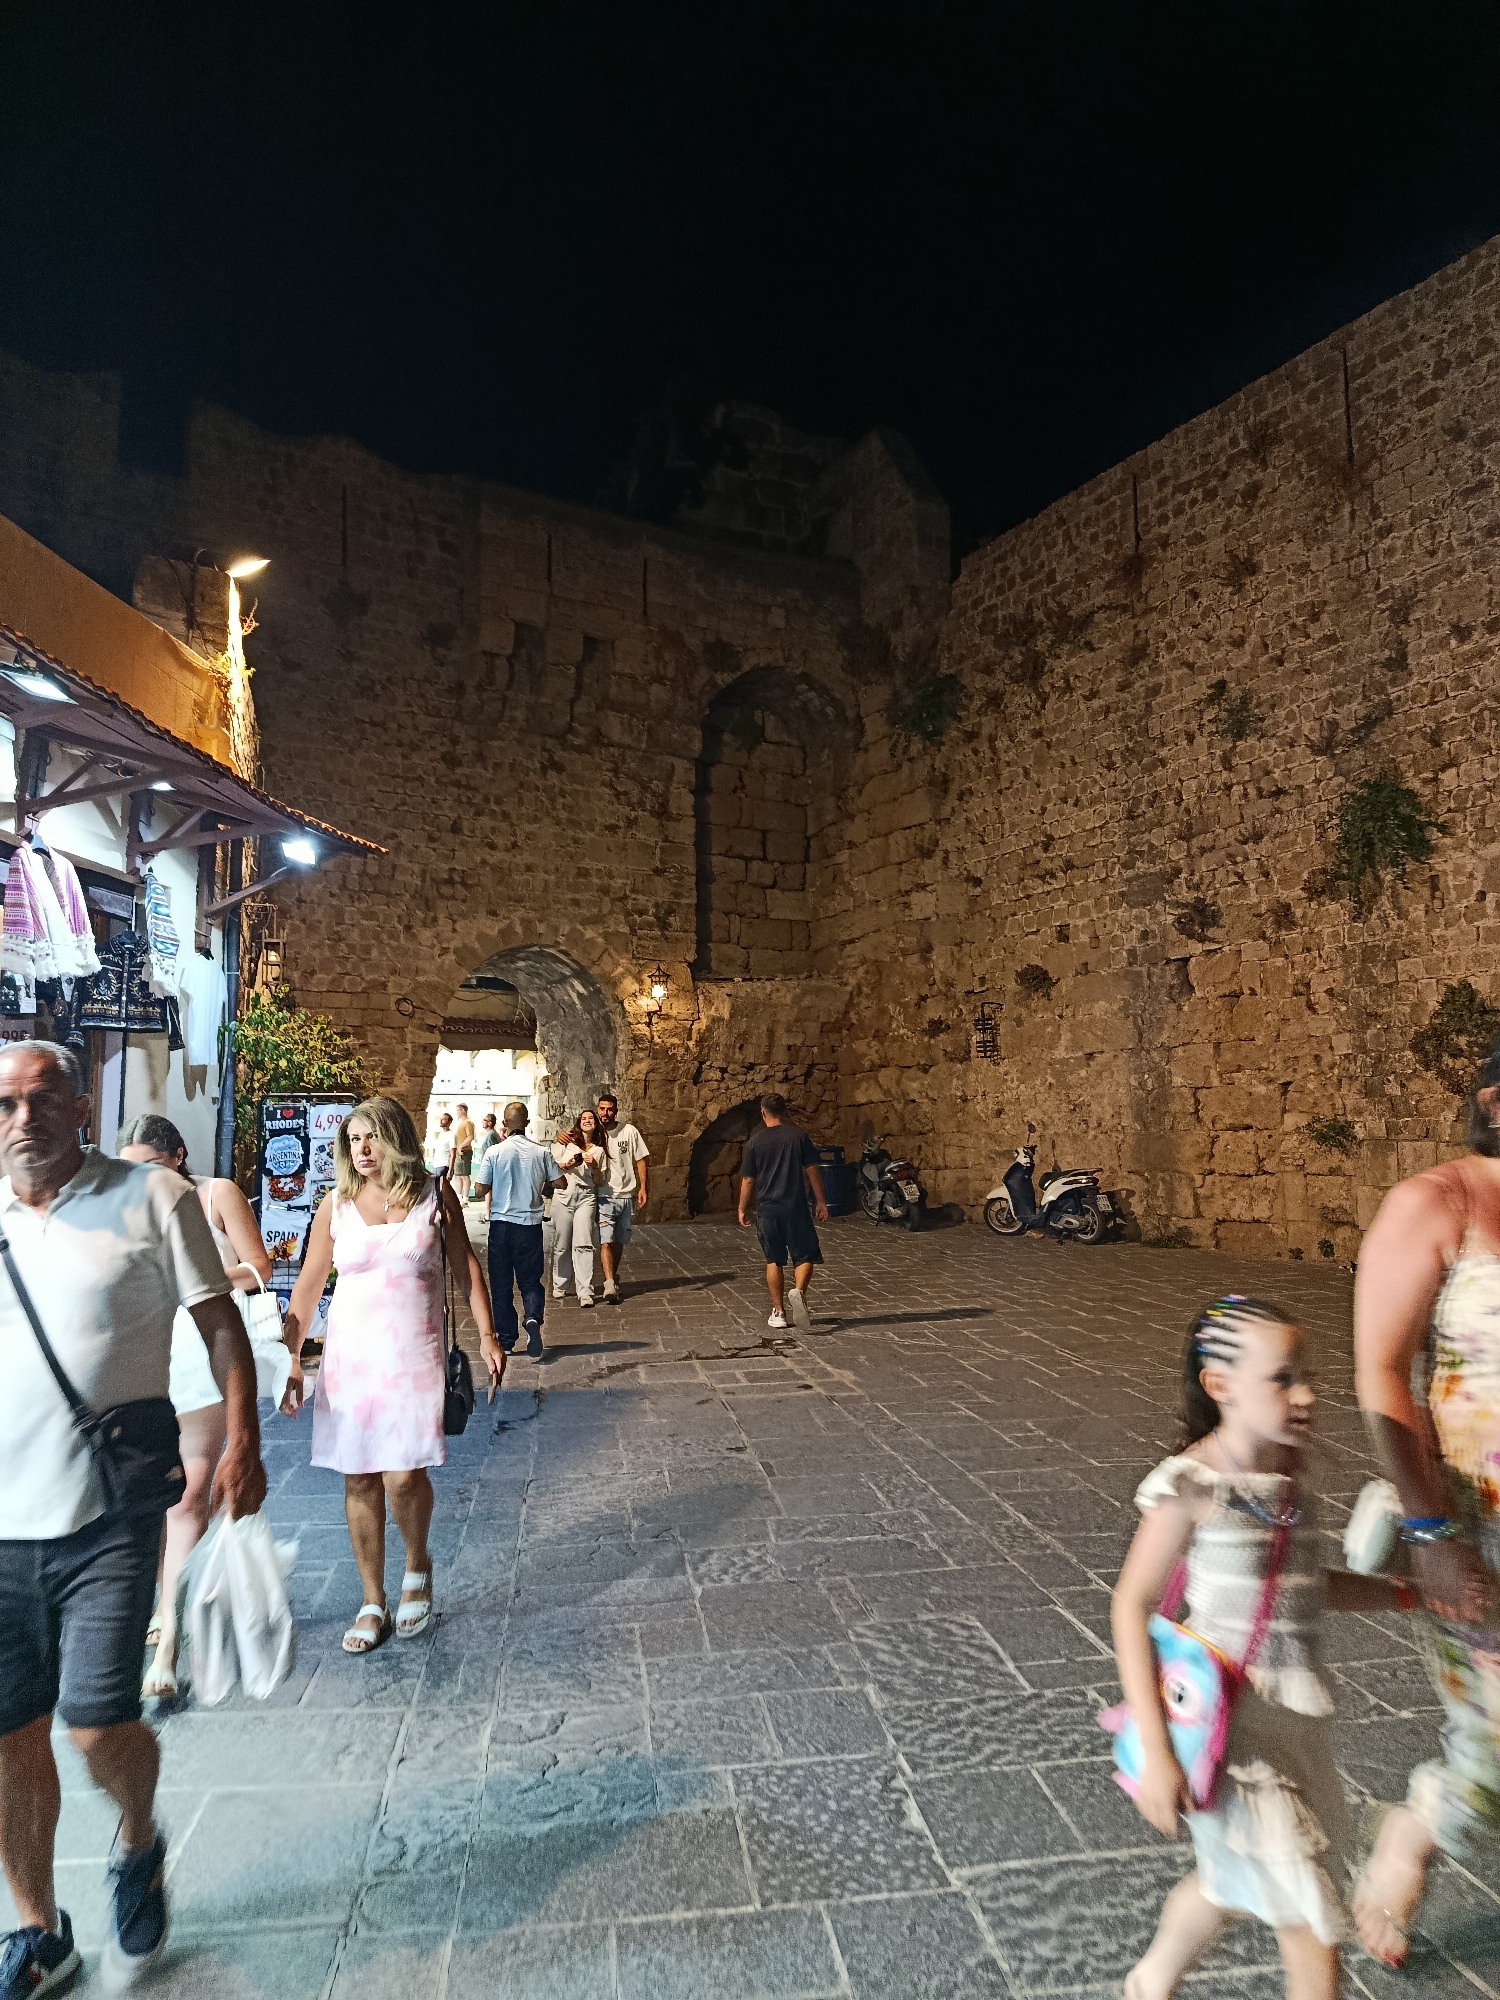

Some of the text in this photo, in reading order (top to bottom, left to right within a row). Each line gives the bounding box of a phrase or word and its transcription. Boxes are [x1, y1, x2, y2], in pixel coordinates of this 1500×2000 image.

[265, 1119, 304, 1130] RHODES
[269, 1151, 300, 1162] ARGENTINA
[266, 1230, 298, 1242] SPAIN
